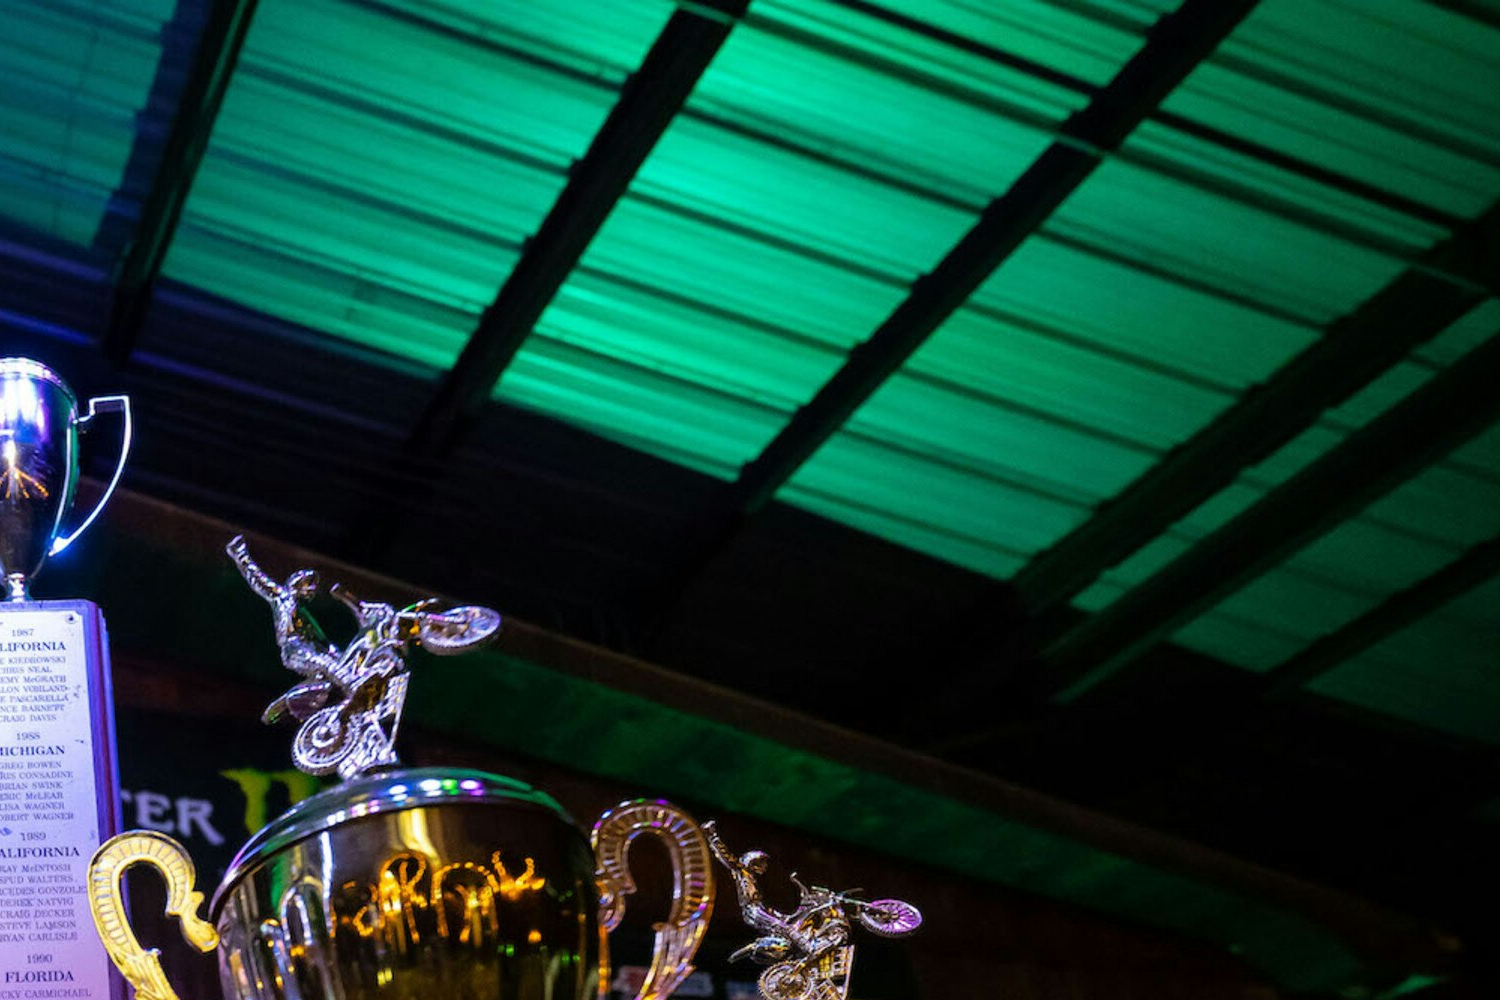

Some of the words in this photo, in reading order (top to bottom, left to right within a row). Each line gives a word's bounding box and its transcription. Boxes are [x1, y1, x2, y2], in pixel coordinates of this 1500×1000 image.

[32, 781, 63, 789] SWINK
[24, 802, 65, 810] WAGNER
[22, 832, 46, 841] 1989
[28, 875, 74, 884] WALTERS
[0, 934, 25, 943] RYAN
[28, 932, 78, 941] CARLISLE
[27, 955, 52, 964] 1990
[5, 971, 75, 983] FLORIDA
[25, 989, 91, 998] CARMICHAEL
